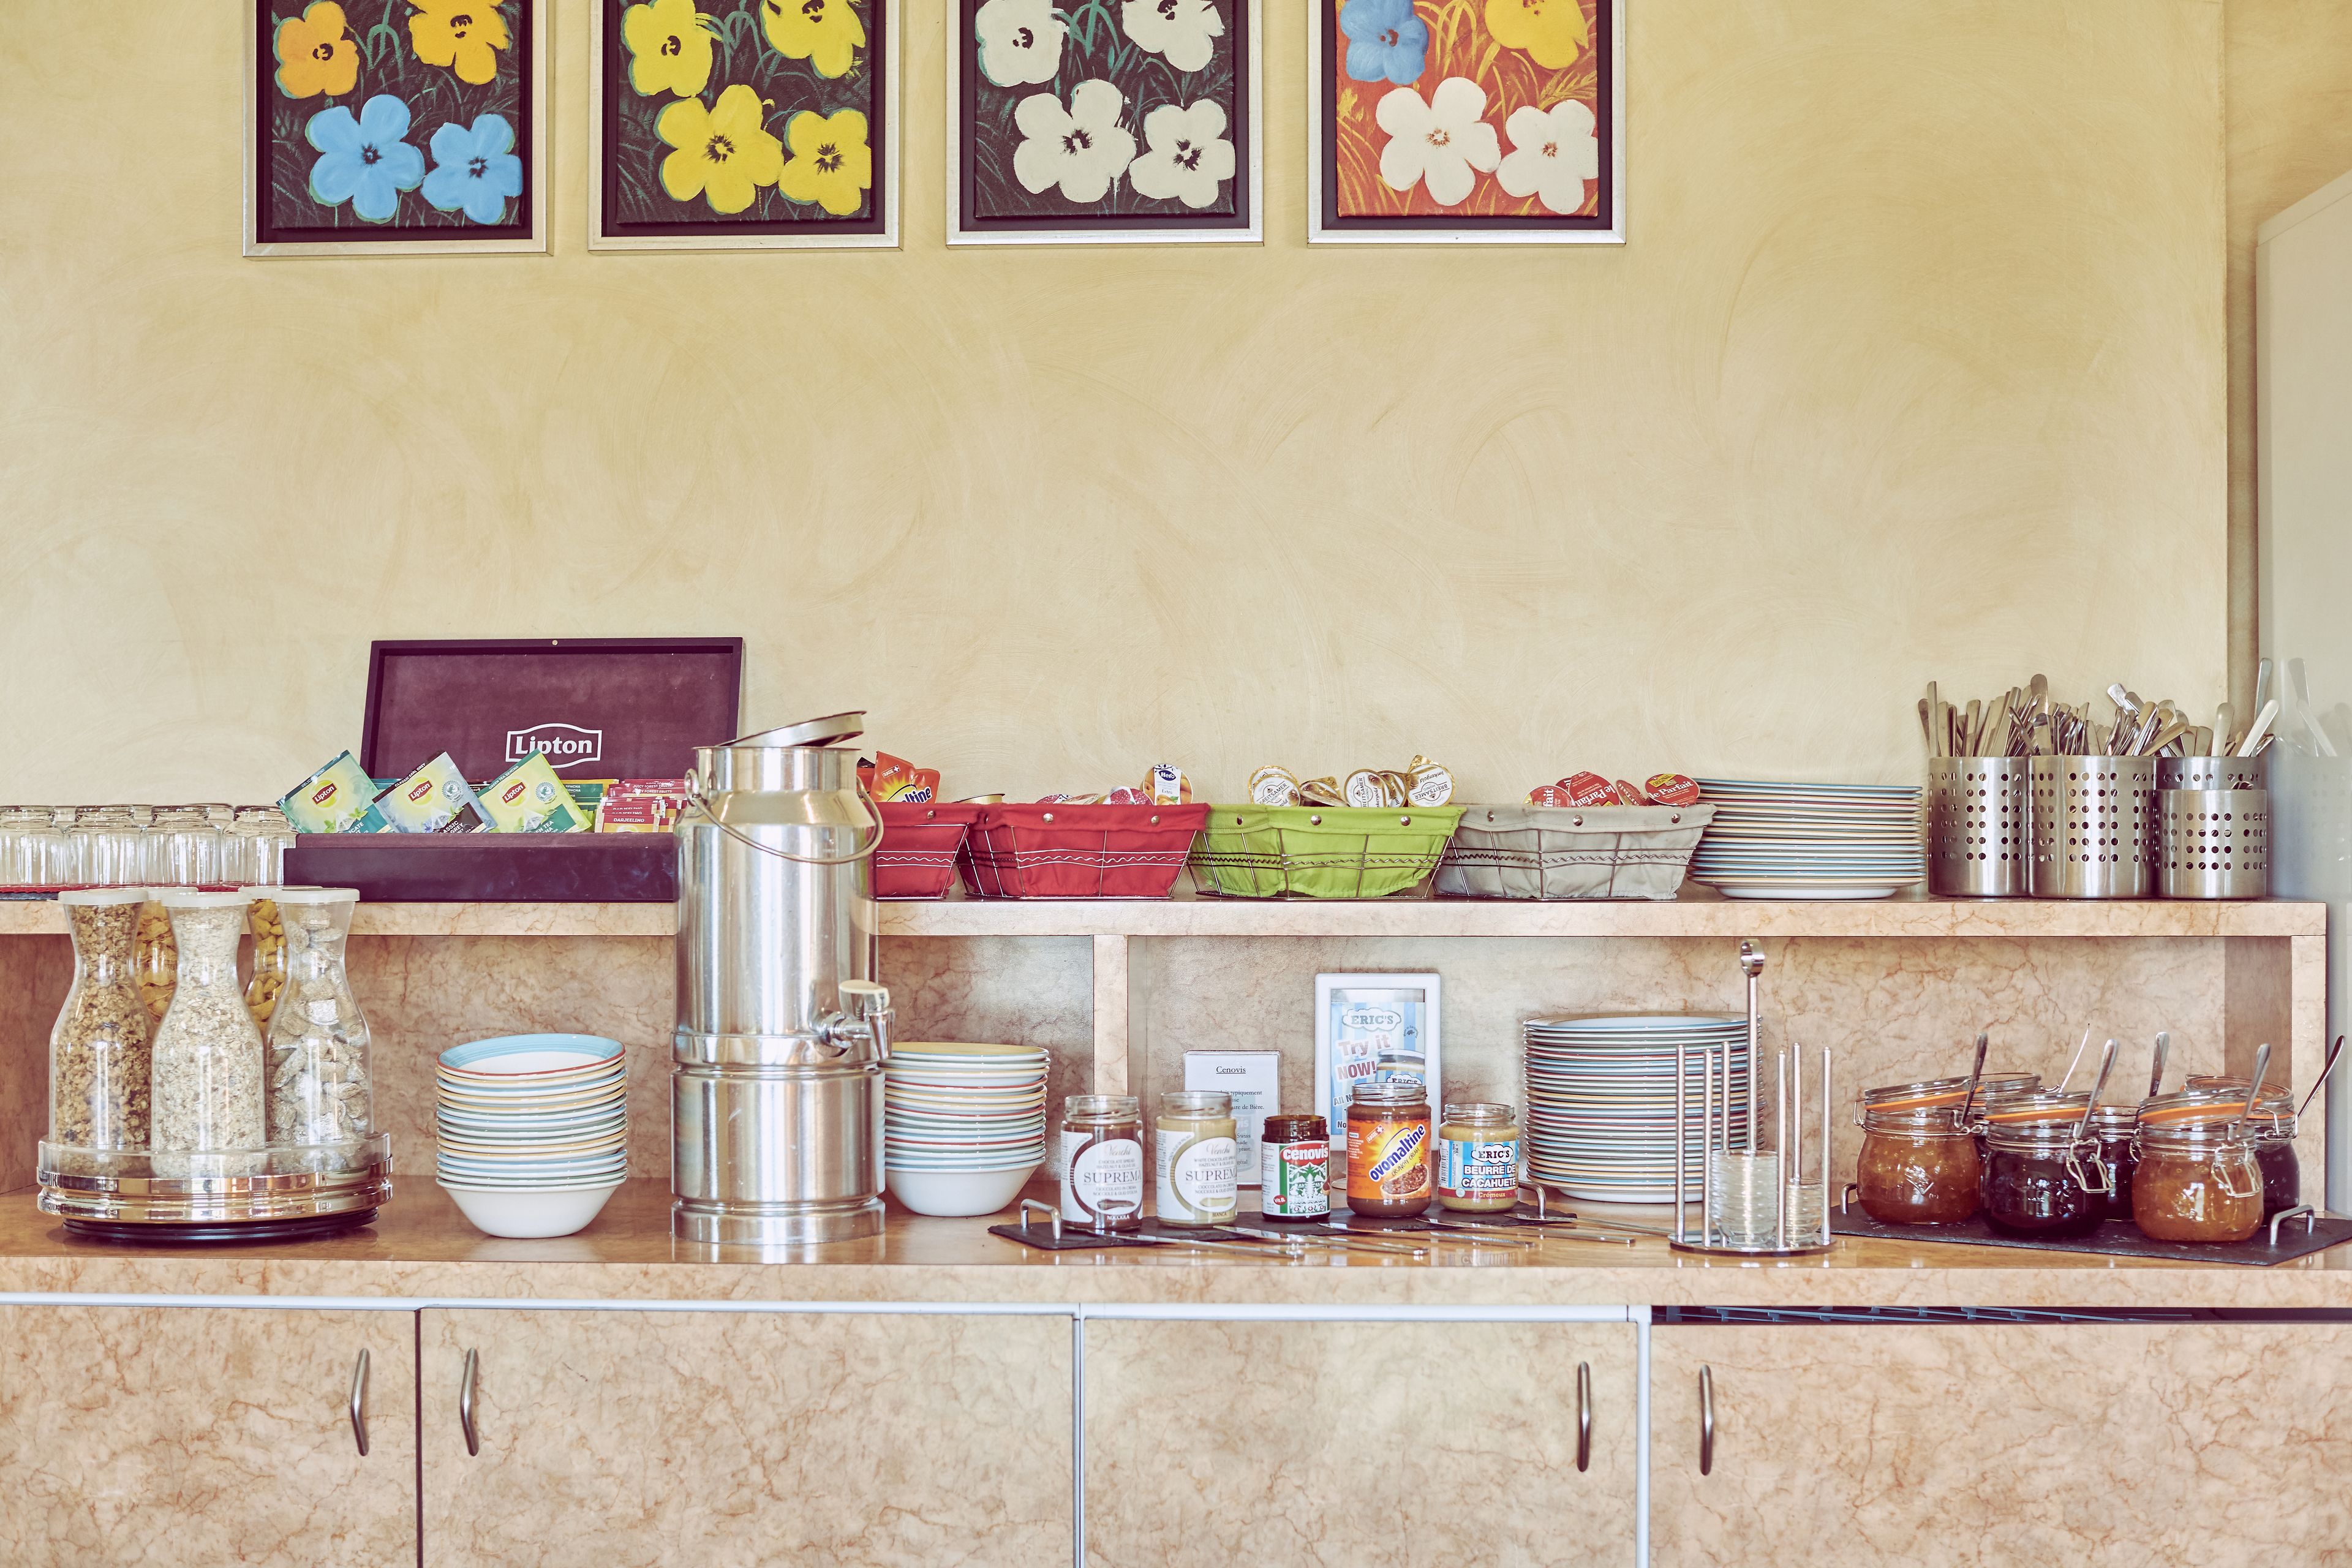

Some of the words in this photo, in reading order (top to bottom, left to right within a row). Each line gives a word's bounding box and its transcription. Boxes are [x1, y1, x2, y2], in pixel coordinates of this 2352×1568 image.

[515, 736, 592, 755] Lipton
[395, 776, 410, 787] CLASSIC
[417, 763, 426, 771] GREY
[489, 780, 499, 790] GREEN
[505, 766, 519, 777] SENCHA
[1420, 771, 1444, 784] Imkergold
[1653, 774, 1672, 786] ORIGINAL
[314, 786, 334, 802] Lipton
[410, 782, 431, 799] Lipton
[504, 785, 524, 801] Lipton
[902, 787, 932, 803] ltine
[1358, 777, 1367, 807] REITSAMER
[1415, 784, 1448, 800] BREITSAMER
[1658, 780, 1694, 795] Parfait
[349, 821, 364, 833] ICATE
[442, 820, 459, 833] ASSIC
[543, 820, 554, 830] TEA
[1351, 1015, 1393, 1025] ERIC'S
[1338, 1039, 1369, 1057] Try
[1375, 1034, 1391, 1050] it
[1337, 1061, 1377, 1080] NOW!
[1334, 1096, 1344, 1106] All
[1106, 1144, 1132, 1156] Venchi
[1206, 1143, 1230, 1155] Venchi
[1370, 1125, 1425, 1181] ovomaltine
[1479, 1150, 1510, 1159] ERIC'S
[1391, 1159, 1409, 1177] CRUNCHY
[1409, 1147, 1420, 1161] CREAM
[1463, 1164, 1506, 1175] BEURRE
[1506, 1164, 1516, 1175] DE
[1084, 1169, 1142, 1183] SUPREMA
